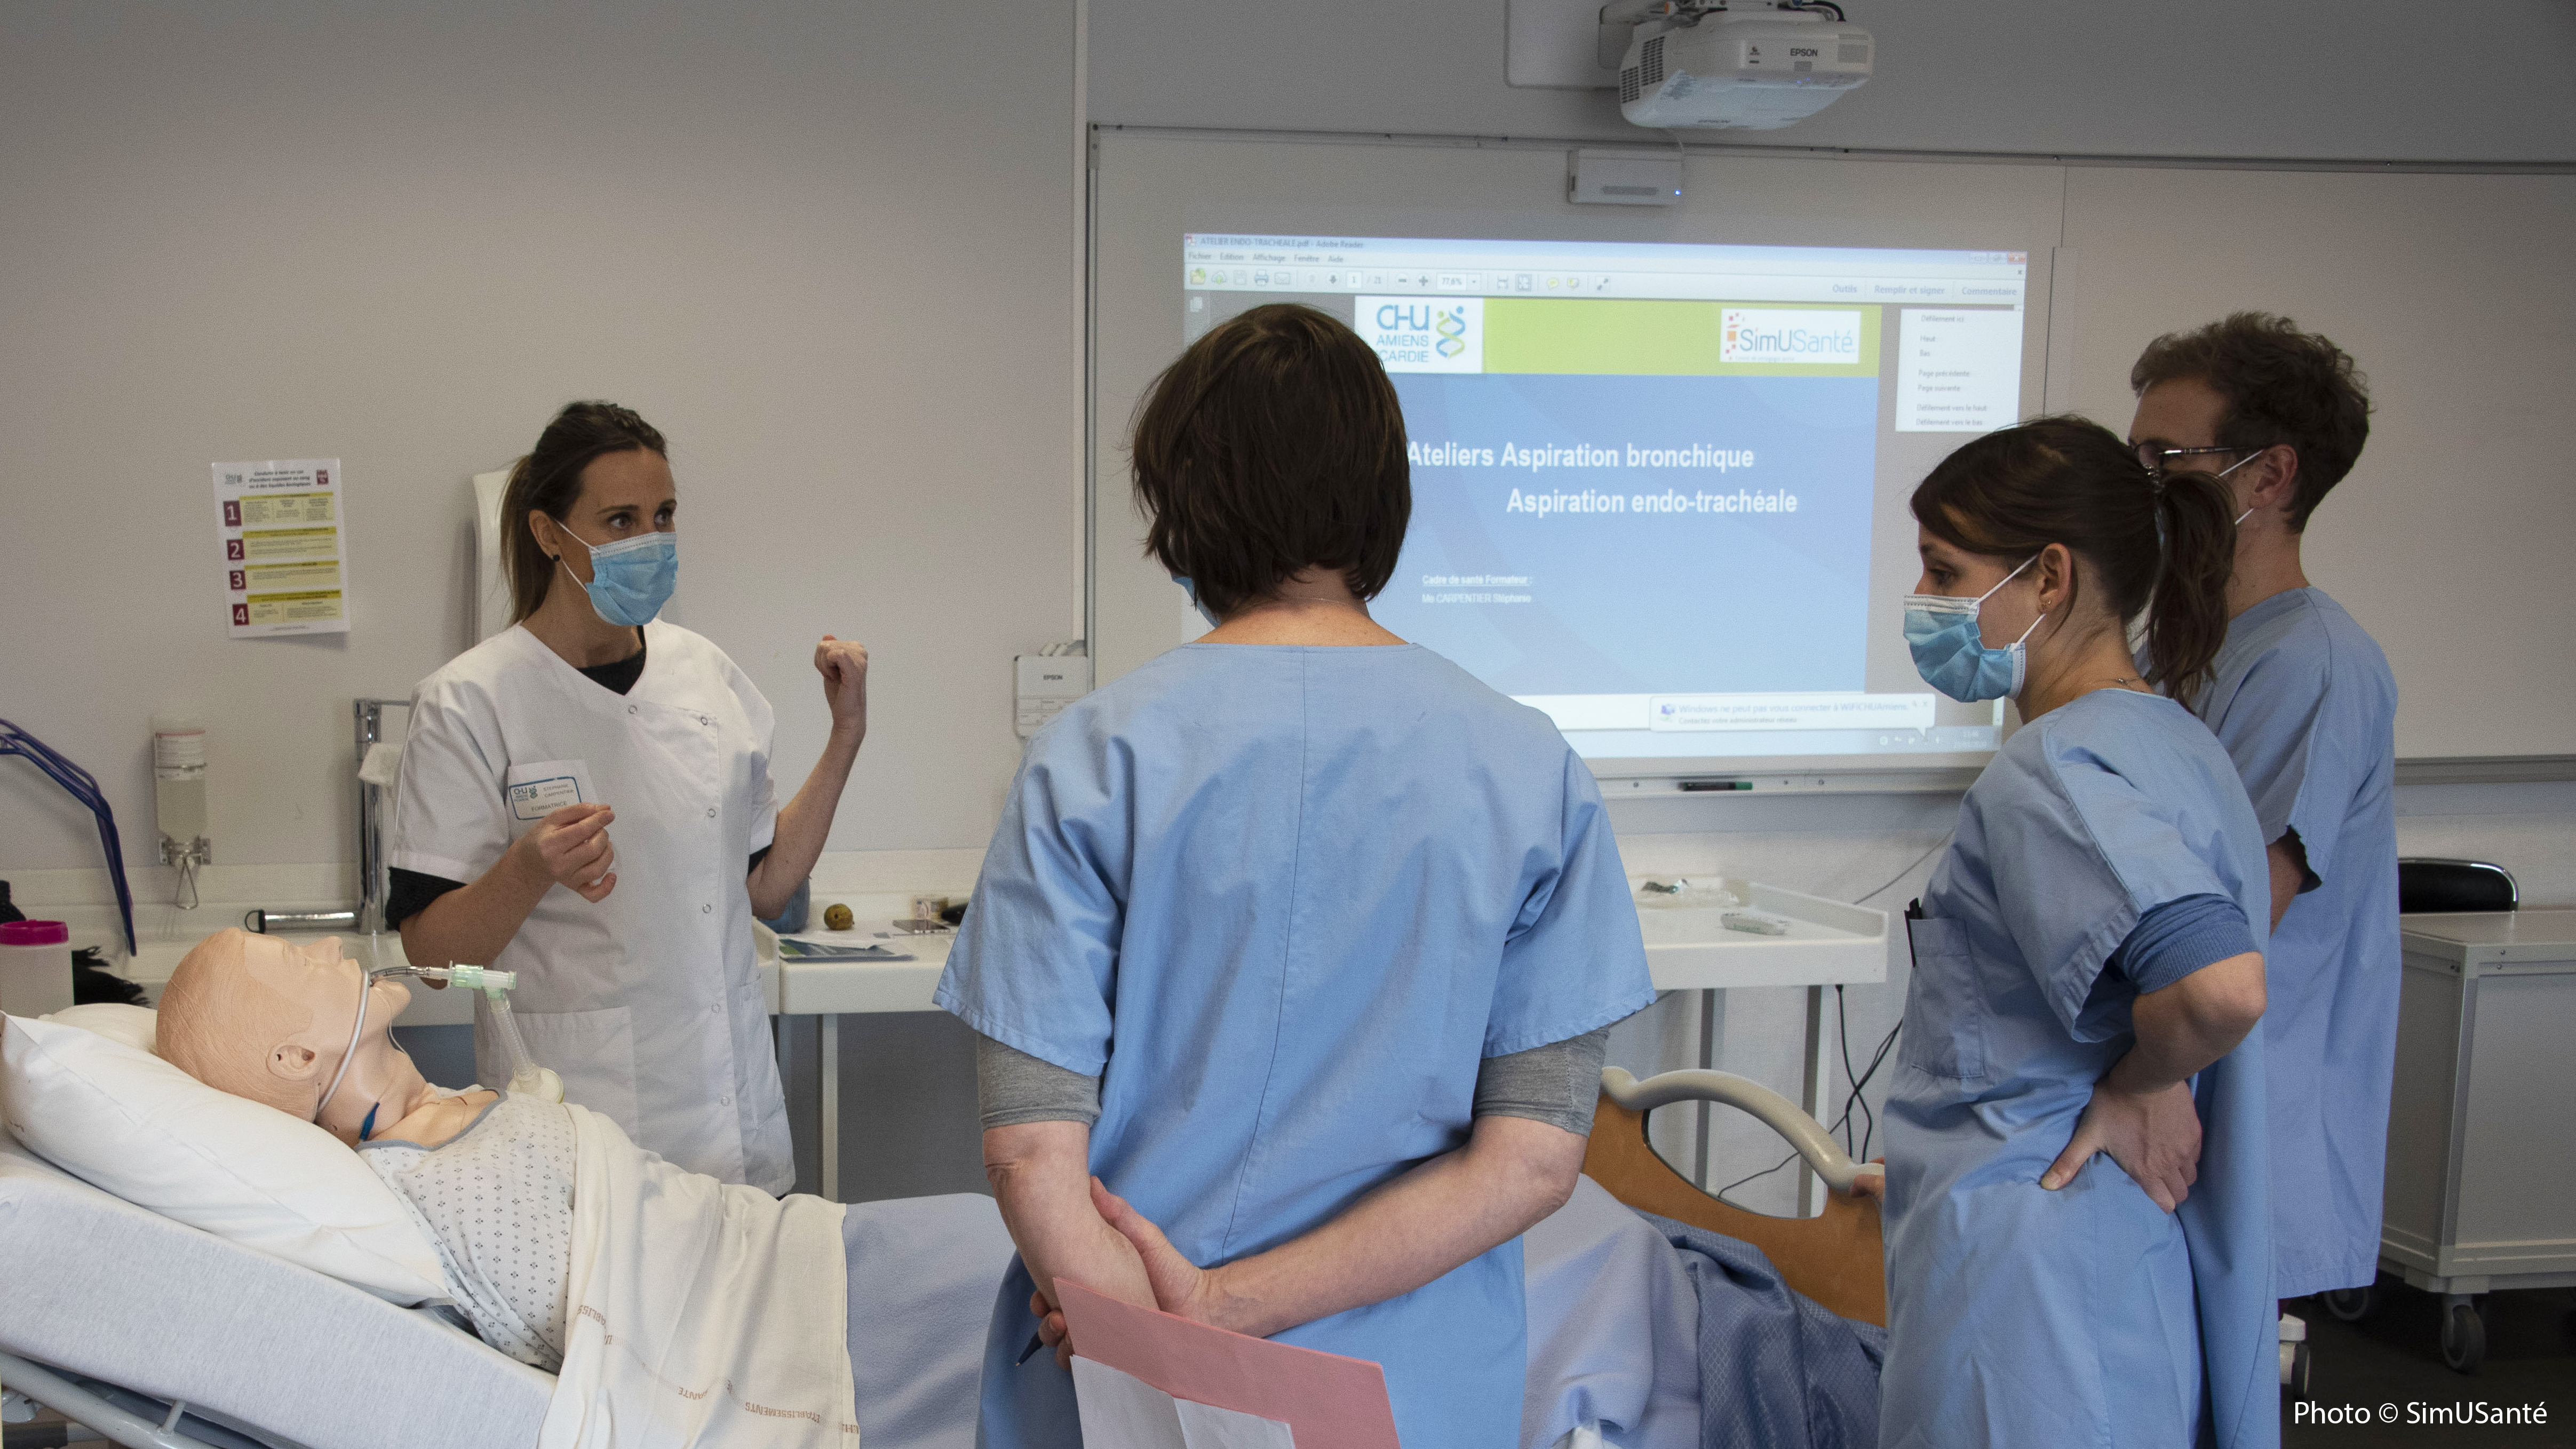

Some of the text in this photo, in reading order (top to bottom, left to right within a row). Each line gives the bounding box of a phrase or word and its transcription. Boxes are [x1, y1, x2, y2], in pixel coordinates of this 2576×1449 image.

[1790, 48, 1818, 57] EPSON
[1253, 253, 1285, 263] Affichage
[1832, 284, 2017, 296] Outils Remplir et signer Commentaire
[1376, 304, 1430, 331] CHU
[1376, 334, 1429, 347] AMIENS
[1739, 327, 1854, 353] SimUSanté
[1378, 350, 1429, 363] CARDIE
[1918, 369, 1970, 378] Page précédente
[1918, 384, 1933, 393] Page
[1973, 404, 1987, 412] haut
[1407, 441, 1754, 473] Ateliers Aspiration bronchique
[1506, 488, 1798, 519] Aspiration endo-trachéale
[227, 506, 237, 521] 1
[230, 543, 241, 558] 2
[232, 572, 242, 588] 3
[1448, 575, 1460, 584] de
[1485, 574, 1528, 584] Formateur
[235, 608, 246, 623] 4
[1678, 704, 1718, 714] Windows
[1720, 705, 1730, 713] ne
[1732, 703, 1750, 714] peut
[1753, 704, 1768, 714] pas
[1769, 704, 1789, 713] vous
[1791, 703, 1831, 712] connecter
[1729, 715, 1775, 724] administrateur
[531, 801, 567, 812] FORMATRICE
